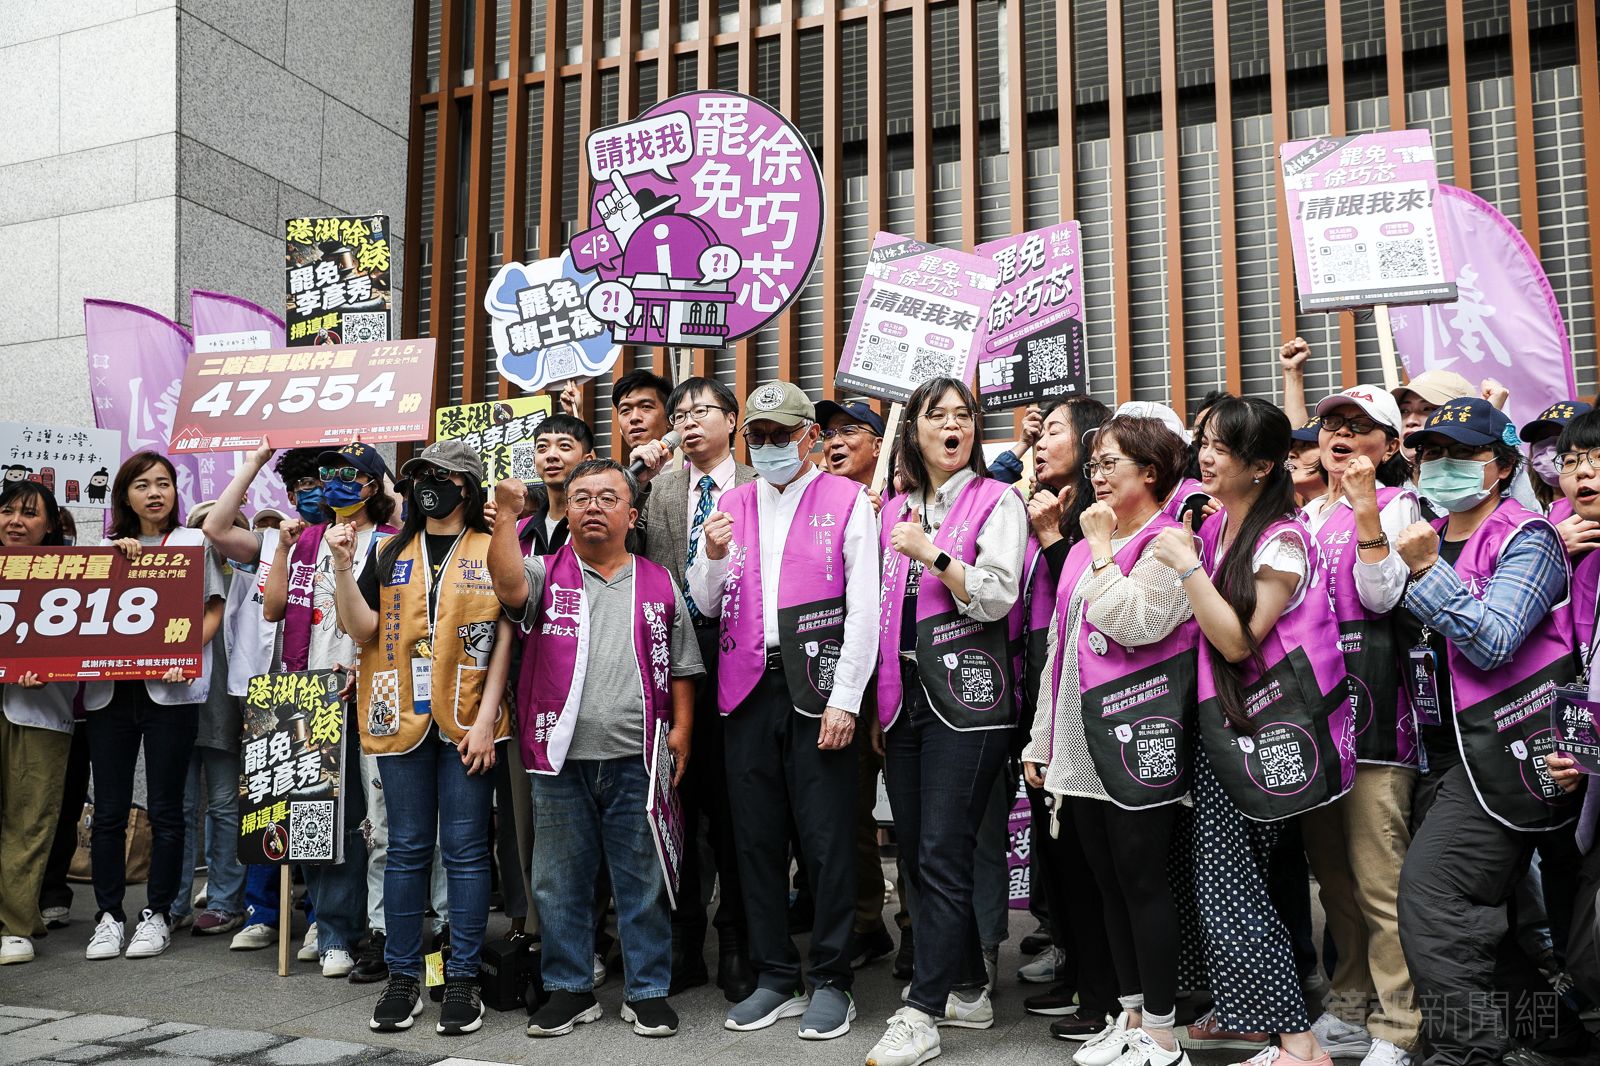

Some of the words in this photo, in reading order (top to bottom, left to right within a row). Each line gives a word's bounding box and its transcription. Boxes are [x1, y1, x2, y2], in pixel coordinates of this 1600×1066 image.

[595, 123, 687, 170] 請找我
[690, 98, 748, 218] 罷免
[1339, 145, 1387, 168] 罷免
[1323, 163, 1398, 189] 徐巧芯
[736, 125, 803, 312] 徐巧芯
[711, 253, 729, 273] ?!
[918, 254, 961, 279] 罷免
[992, 235, 1046, 289] 罷免
[290, 261, 340, 294] 罷免
[897, 268, 962, 298] 徐巧芯
[296, 275, 372, 316] 李彥秀
[518, 280, 581, 319] 罷免
[601, 290, 621, 313] ?!
[988, 262, 1076, 334] 徐巧芯
[198, 350, 357, 376] 二階連署收件量
[879, 352, 893, 361] LINE
[191, 371, 395, 420] 47,554
[398, 393, 422, 415] 份
[445, 410, 546, 454] 免李彥秀
[0, 554, 113, 580] 署送件量
[127, 569, 187, 579] 達標安全門檻
[457, 557, 483, 569] 文山
[163, 617, 192, 644] 份
[541, 622, 580, 638] 雙北大
[81, 658, 198, 669] 感謝所有志工、鄉親支持與付出!
[244, 730, 292, 775] 罷免
[248, 750, 322, 805] 李彥秀
